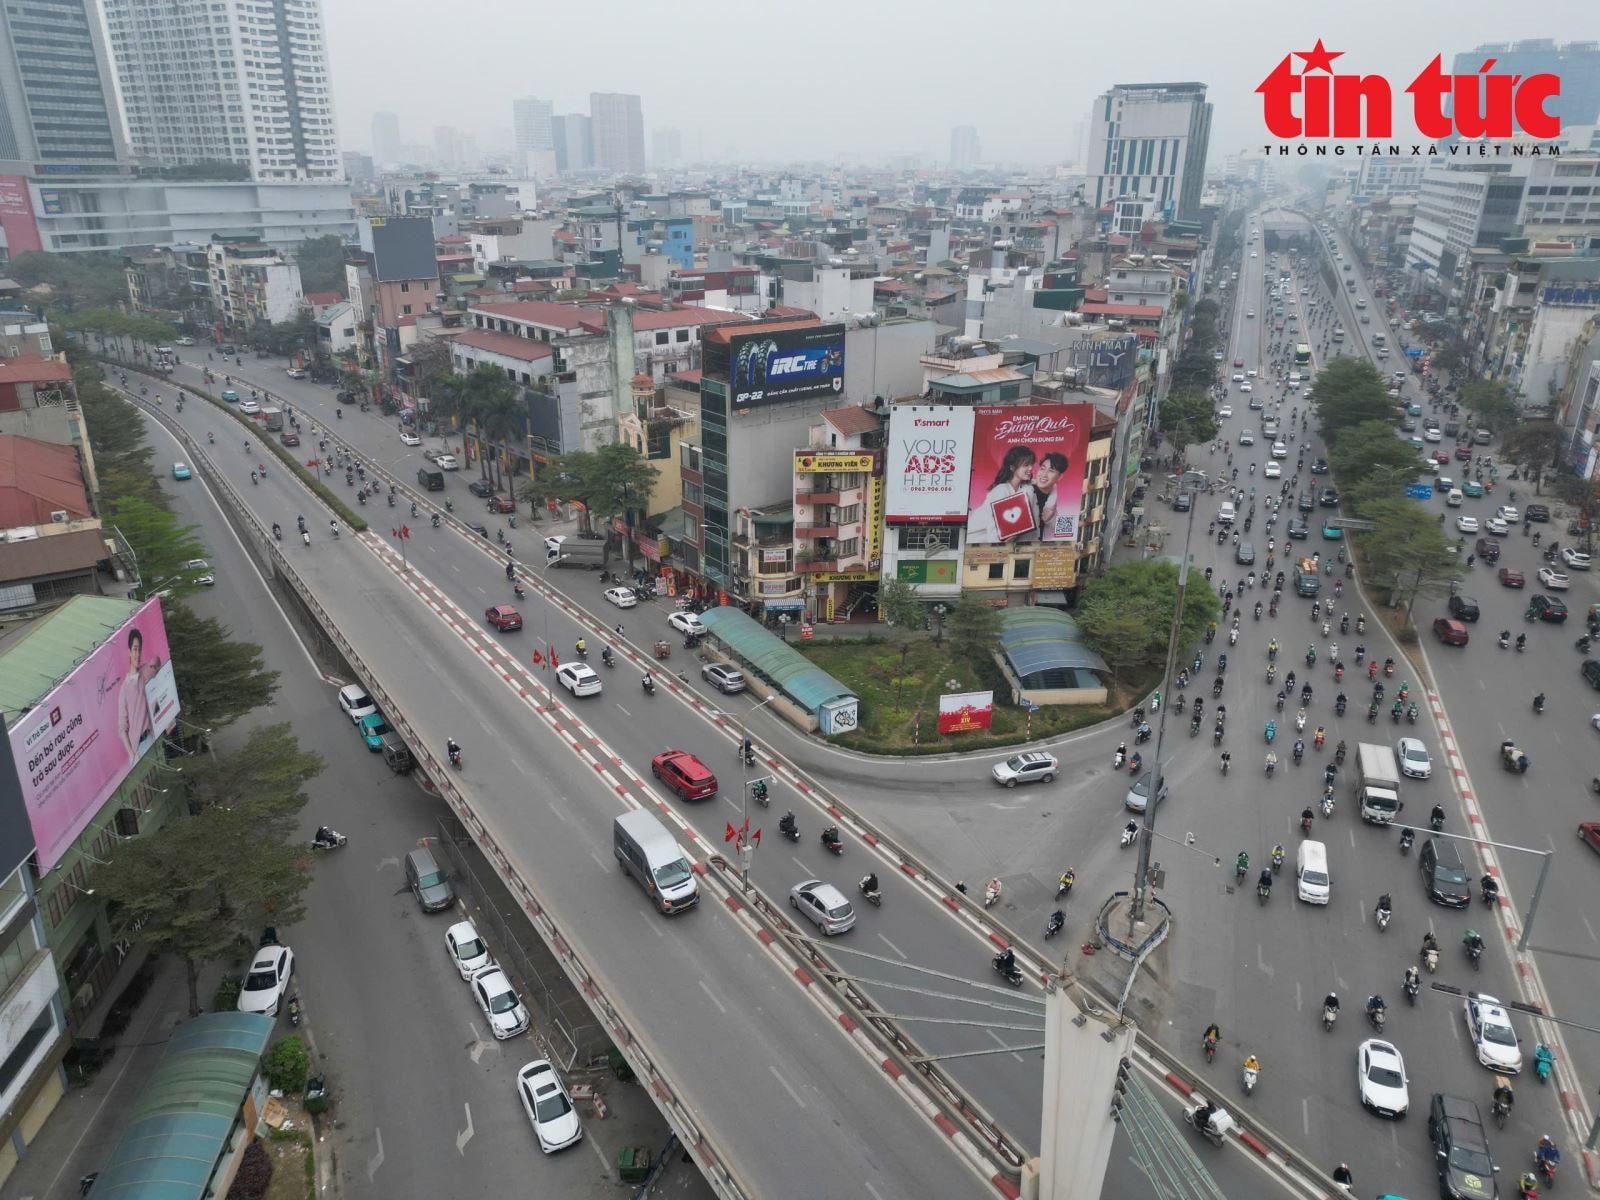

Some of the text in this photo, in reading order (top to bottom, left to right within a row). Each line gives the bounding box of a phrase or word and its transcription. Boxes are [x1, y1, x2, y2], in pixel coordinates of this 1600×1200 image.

[804, 360, 818, 371] TIRE
[1074, 352, 1126, 367] LILY
[736, 391, 763, 402] GP-22
[994, 416, 1075, 440] Đúng Quà
[903, 440, 957, 463] YOUR
[904, 455, 956, 474] ADS
[903, 473, 954, 486] HERE
[28, 713, 83, 773] Đến bó rau cũng
[32, 739, 75, 787] trả sau được
